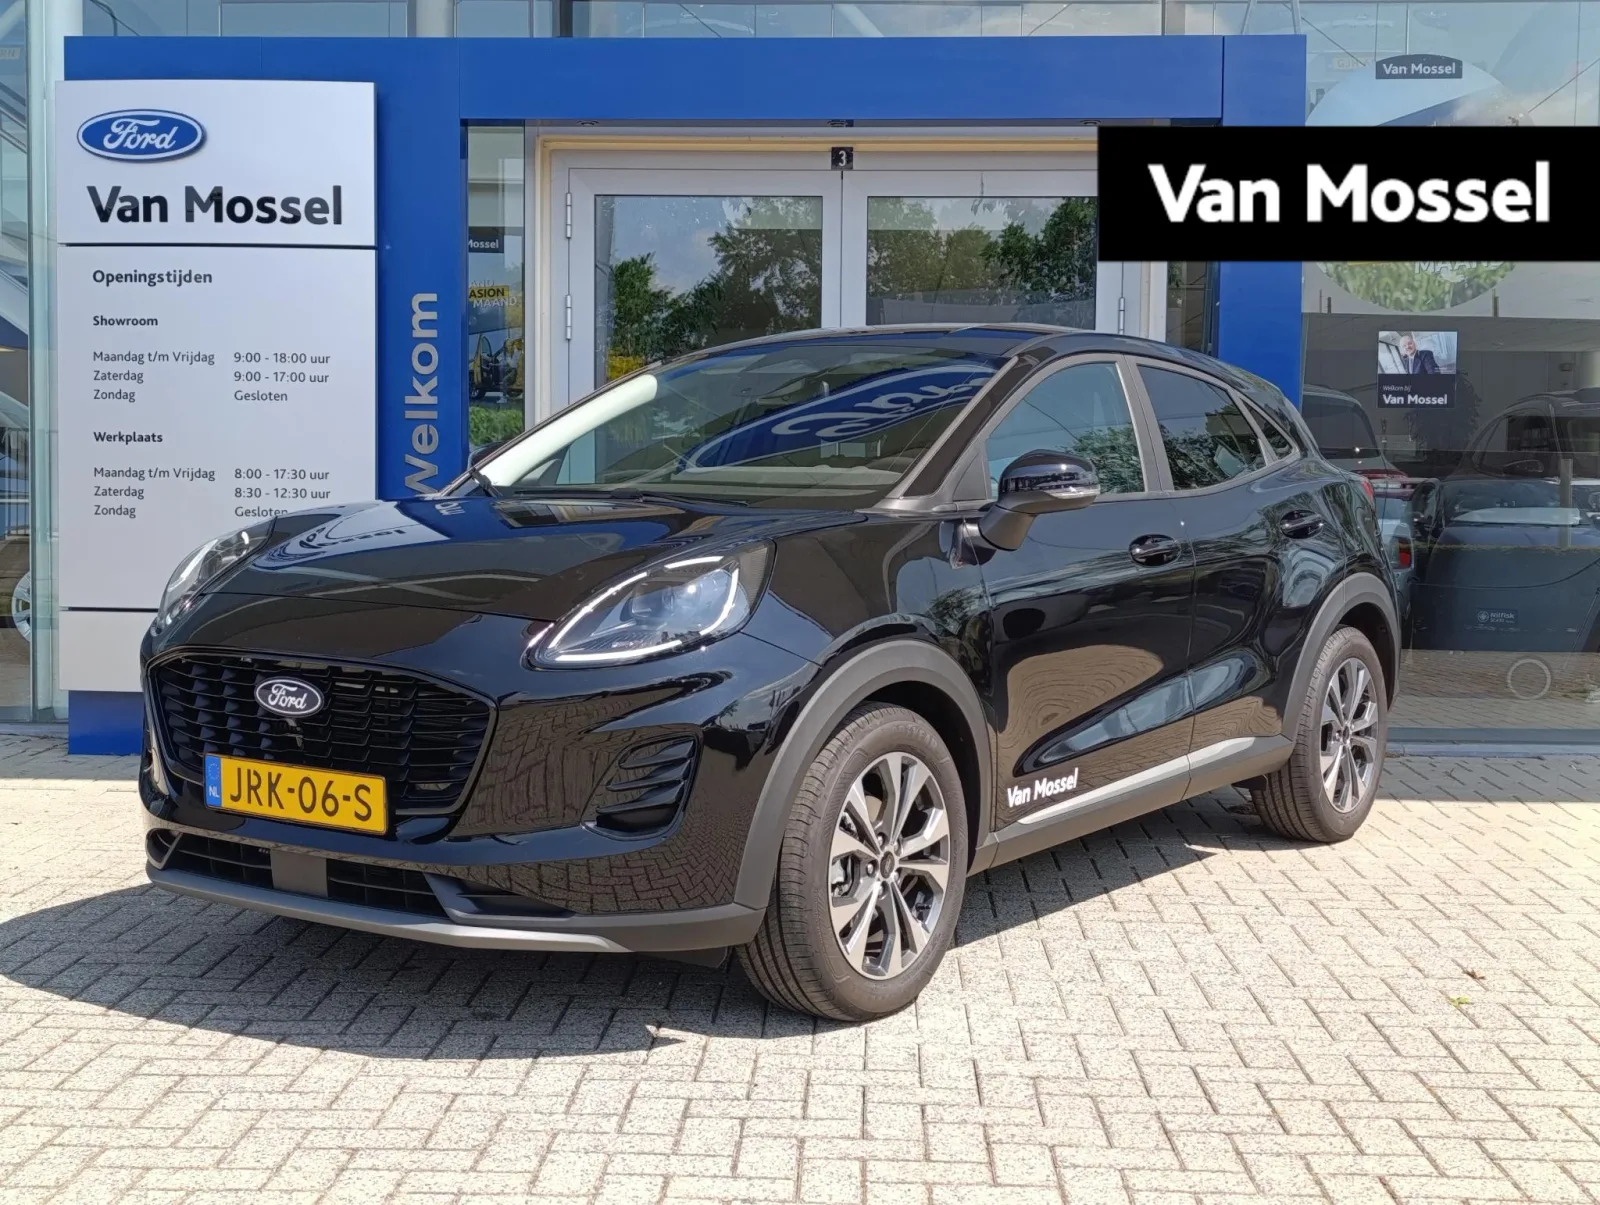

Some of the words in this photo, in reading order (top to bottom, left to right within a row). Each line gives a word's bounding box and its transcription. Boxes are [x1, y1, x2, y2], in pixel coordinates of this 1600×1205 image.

[1383, 64, 1407, 75] Van
[1411, 62, 1456, 75] Mossel
[103, 118, 179, 150] Ford
[838, 150, 847, 167] 3
[86, 185, 169, 223] Van
[184, 185, 343, 225] Mossel
[93, 270, 212, 287] Openingstijden
[469, 288, 505, 298] ASION
[473, 296, 518, 309] MAAND
[93, 315, 158, 326] Showroom
[94, 351, 144, 365] Maandag
[148, 351, 168, 362] t/m
[173, 351, 214, 365] Vrijdag
[234, 352, 260, 362] 9:00
[274, 353, 306, 363] 18:00
[94, 370, 143, 384] Zaterdag
[234, 371, 261, 381] 9:00
[274, 372, 305, 382] 17:00
[94, 389, 135, 403] Zondag
[234, 390, 287, 401] Gesloten
[404, 293, 439, 498] Welkom
[1382, 394, 1404, 404] Van
[1407, 394, 1448, 405] Mossel
[94, 431, 163, 445] Werkplaats
[94, 467, 145, 481] Maandag
[148, 468, 169, 478] t/m
[173, 468, 215, 481] Vrijdag
[235, 469, 261, 479] 8:00
[274, 469, 306, 479] 17:30
[310, 472, 329, 480] uur
[94, 486, 144, 500] Zaterdag
[235, 488, 261, 498] 8:30
[274, 488, 307, 498] 12:30
[95, 505, 136, 518] Zondag
[234, 506, 288, 518] Gesloten
[267, 683, 308, 710] Ford
[208, 785, 220, 798] NL
[230, 767, 372, 822] JRK-06-S
[1007, 785, 1031, 808] Van
[1033, 767, 1079, 801] Mossel
